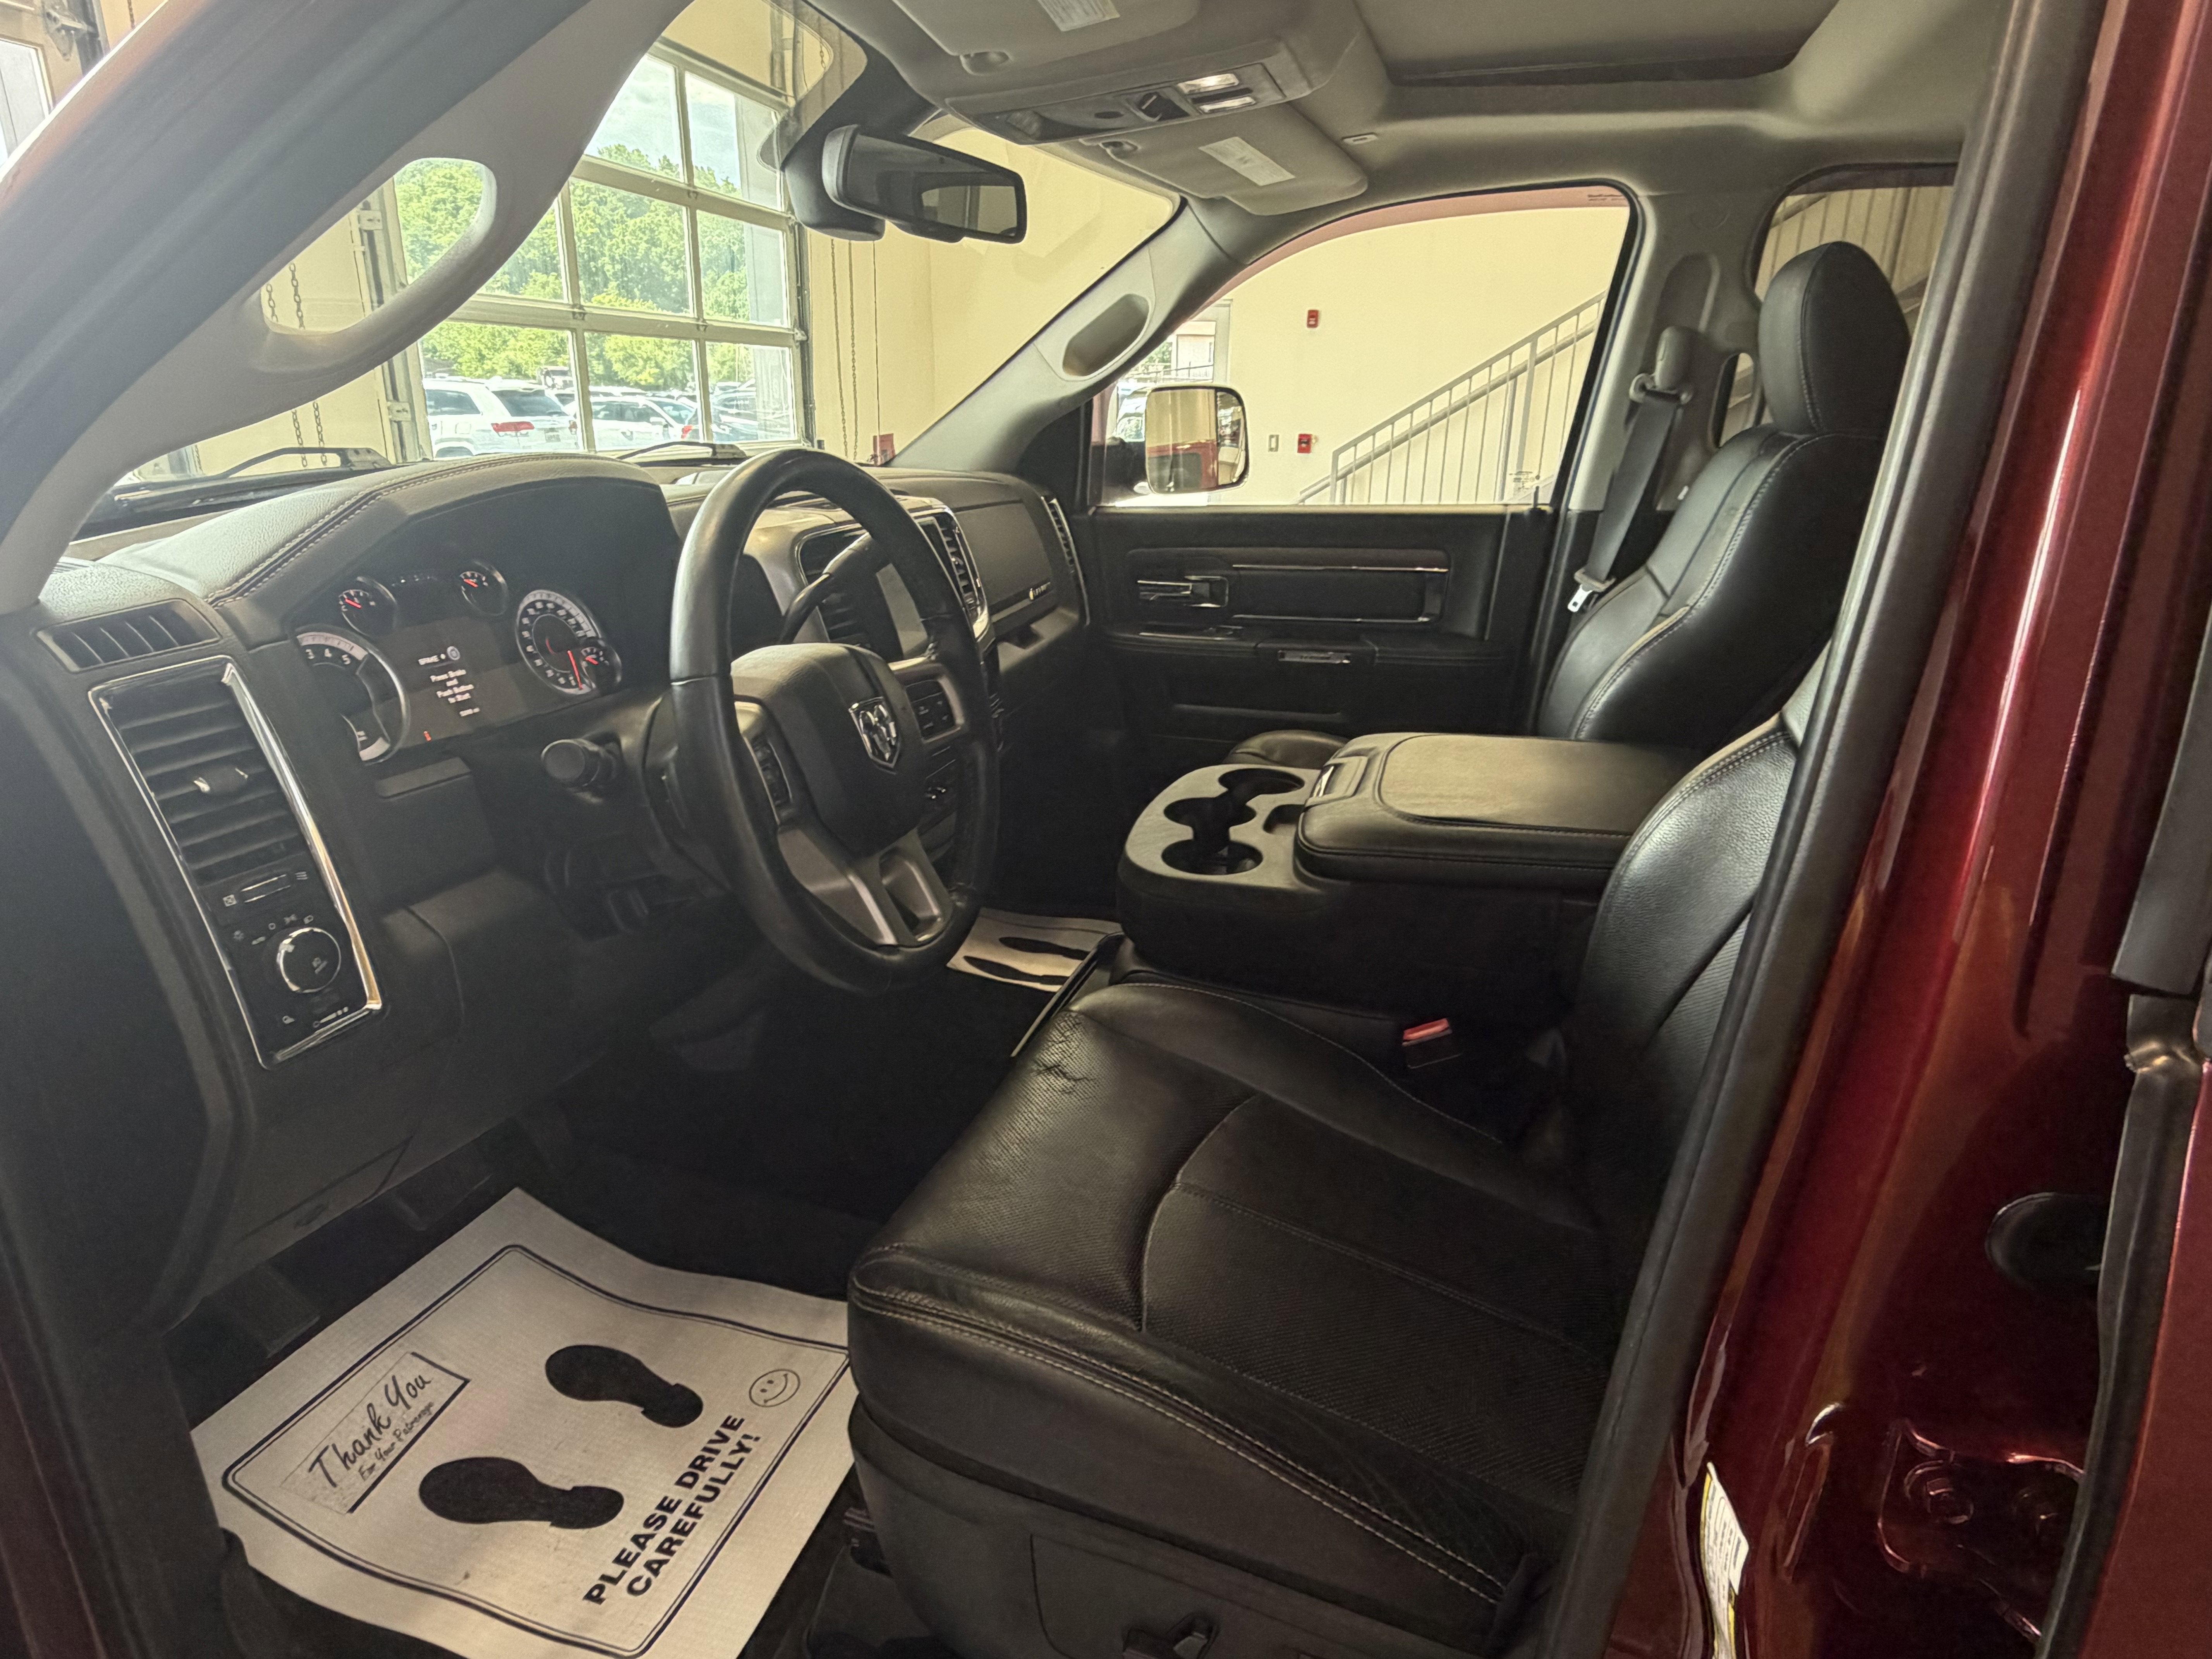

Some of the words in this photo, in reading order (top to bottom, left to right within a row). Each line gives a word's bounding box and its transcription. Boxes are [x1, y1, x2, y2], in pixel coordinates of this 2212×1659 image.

[341, 654, 351, 665] 5
[308, 1402, 391, 1488] Thank
[384, 1375, 432, 1410] You
[358, 1463, 376, 1481] For
[374, 1442, 396, 1462] Your
[392, 1401, 435, 1441] Patronage
[582, 1496, 683, 1605] PLEASE
[674, 1415, 745, 1490] DRIVE
[626, 1434, 761, 1597] CAREFULLY!
